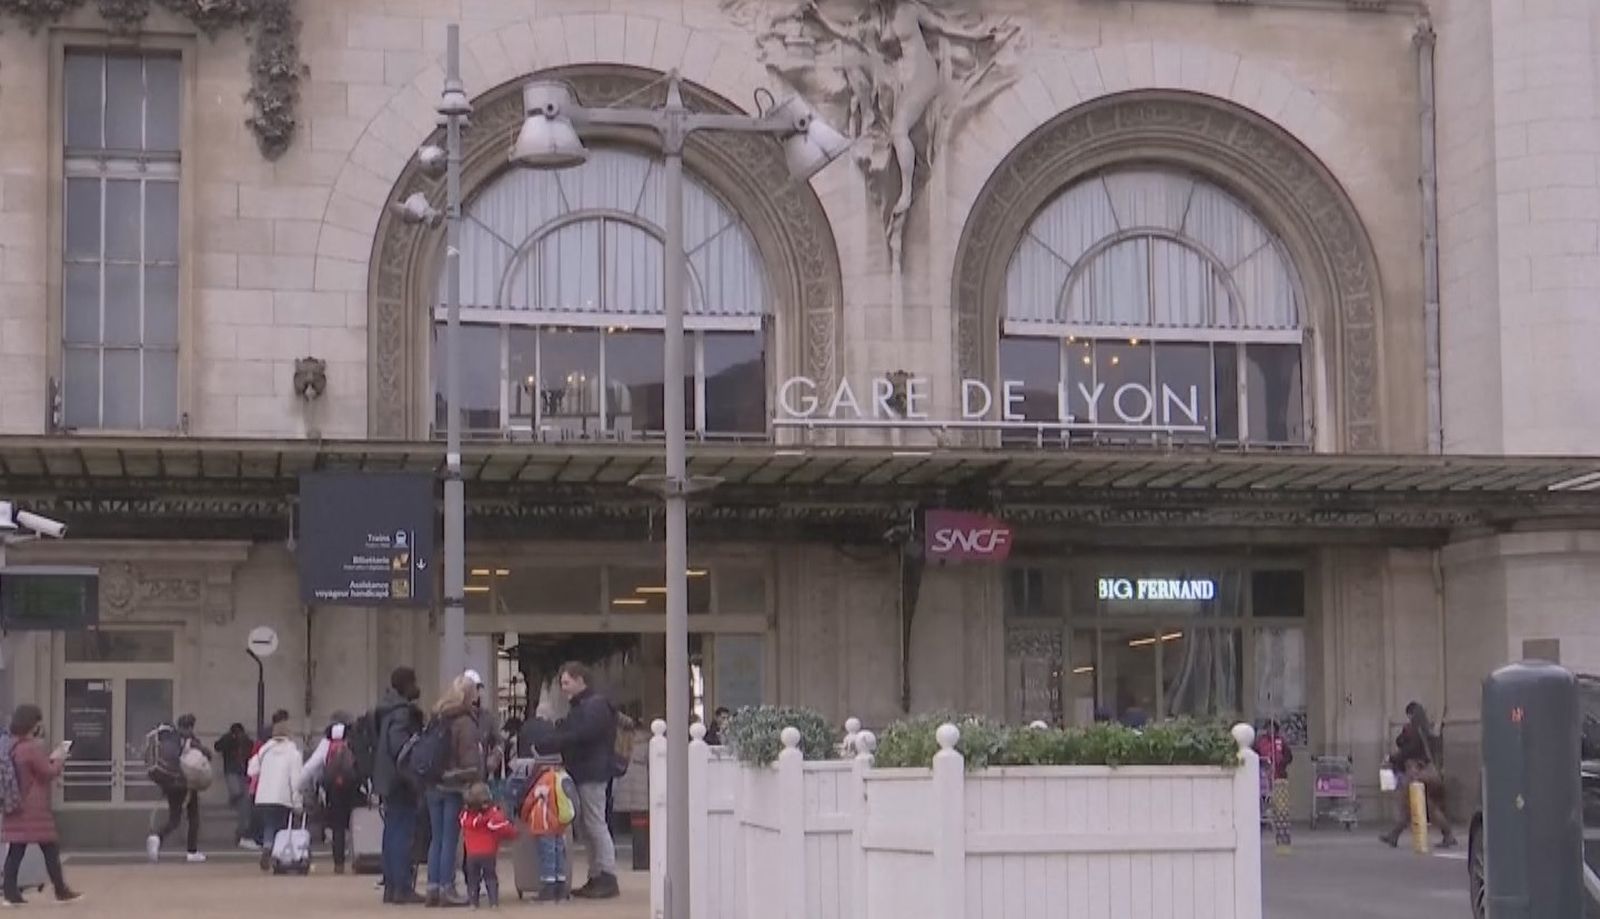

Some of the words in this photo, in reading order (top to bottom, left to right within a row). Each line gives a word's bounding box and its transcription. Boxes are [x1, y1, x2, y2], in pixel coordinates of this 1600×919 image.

[779, 376, 928, 418] GARE
[962, 380, 1025, 421] DE
[1058, 380, 1199, 423] LYON
[931, 528, 1010, 552] SNCF
[1098, 578, 1133, 599] BIG
[1137, 578, 1214, 600] FERNAND
